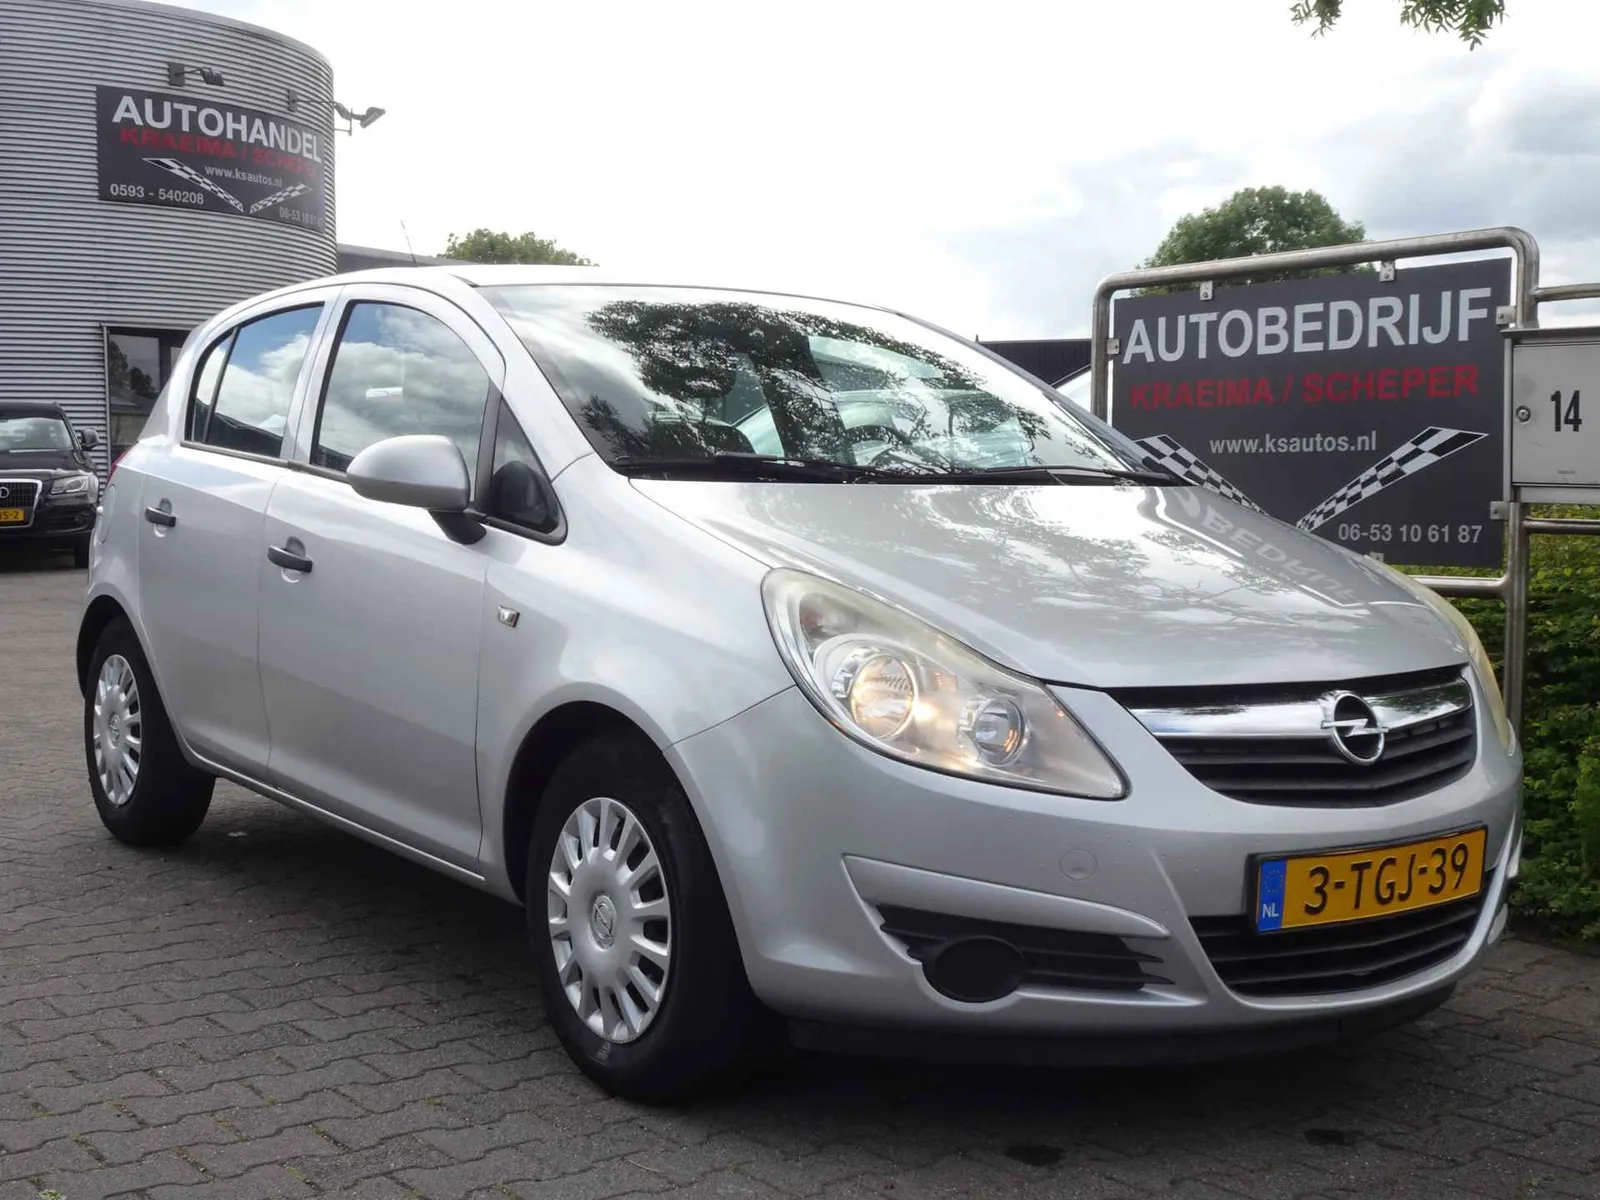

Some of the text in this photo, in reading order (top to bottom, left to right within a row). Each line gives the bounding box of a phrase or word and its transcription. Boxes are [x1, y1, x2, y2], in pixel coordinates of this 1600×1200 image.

[112, 95, 322, 163] AUTOHANDEL
[120, 127, 237, 159] KRAEIMA
[110, 183, 145, 198] 0593
[158, 188, 204, 204] 540208
[204, 166, 282, 188] www.ksautos.nl
[1122, 287, 1492, 365] AUTOBEDRIJF
[1129, 363, 1481, 412] KRAEIMA / SCHEPER
[1550, 390, 1583, 432] 14
[1209, 430, 1377, 454] www.ksautos.nl
[1338, 523, 1483, 543] 06-53 10 61 87
[1261, 842, 1469, 919] NL 3-TGJ-39
